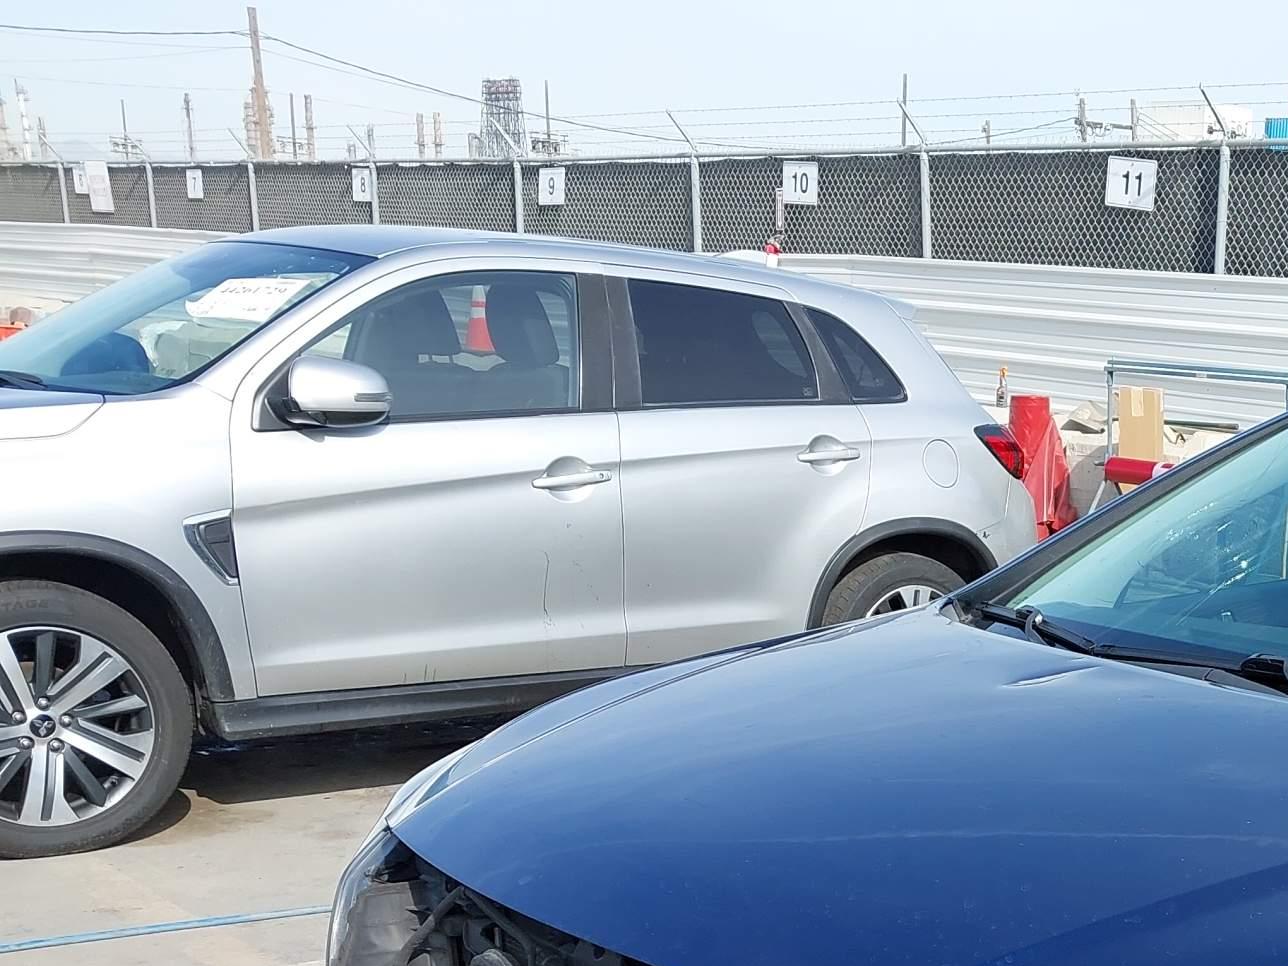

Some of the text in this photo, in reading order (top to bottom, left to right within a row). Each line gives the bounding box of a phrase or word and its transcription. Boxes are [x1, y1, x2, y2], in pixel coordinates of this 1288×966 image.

[192, 176, 197, 193] 7
[360, 176, 366, 193] 8
[548, 176, 555, 195] 9
[792, 172, 809, 194] 10
[1122, 170, 1142, 197] 11
